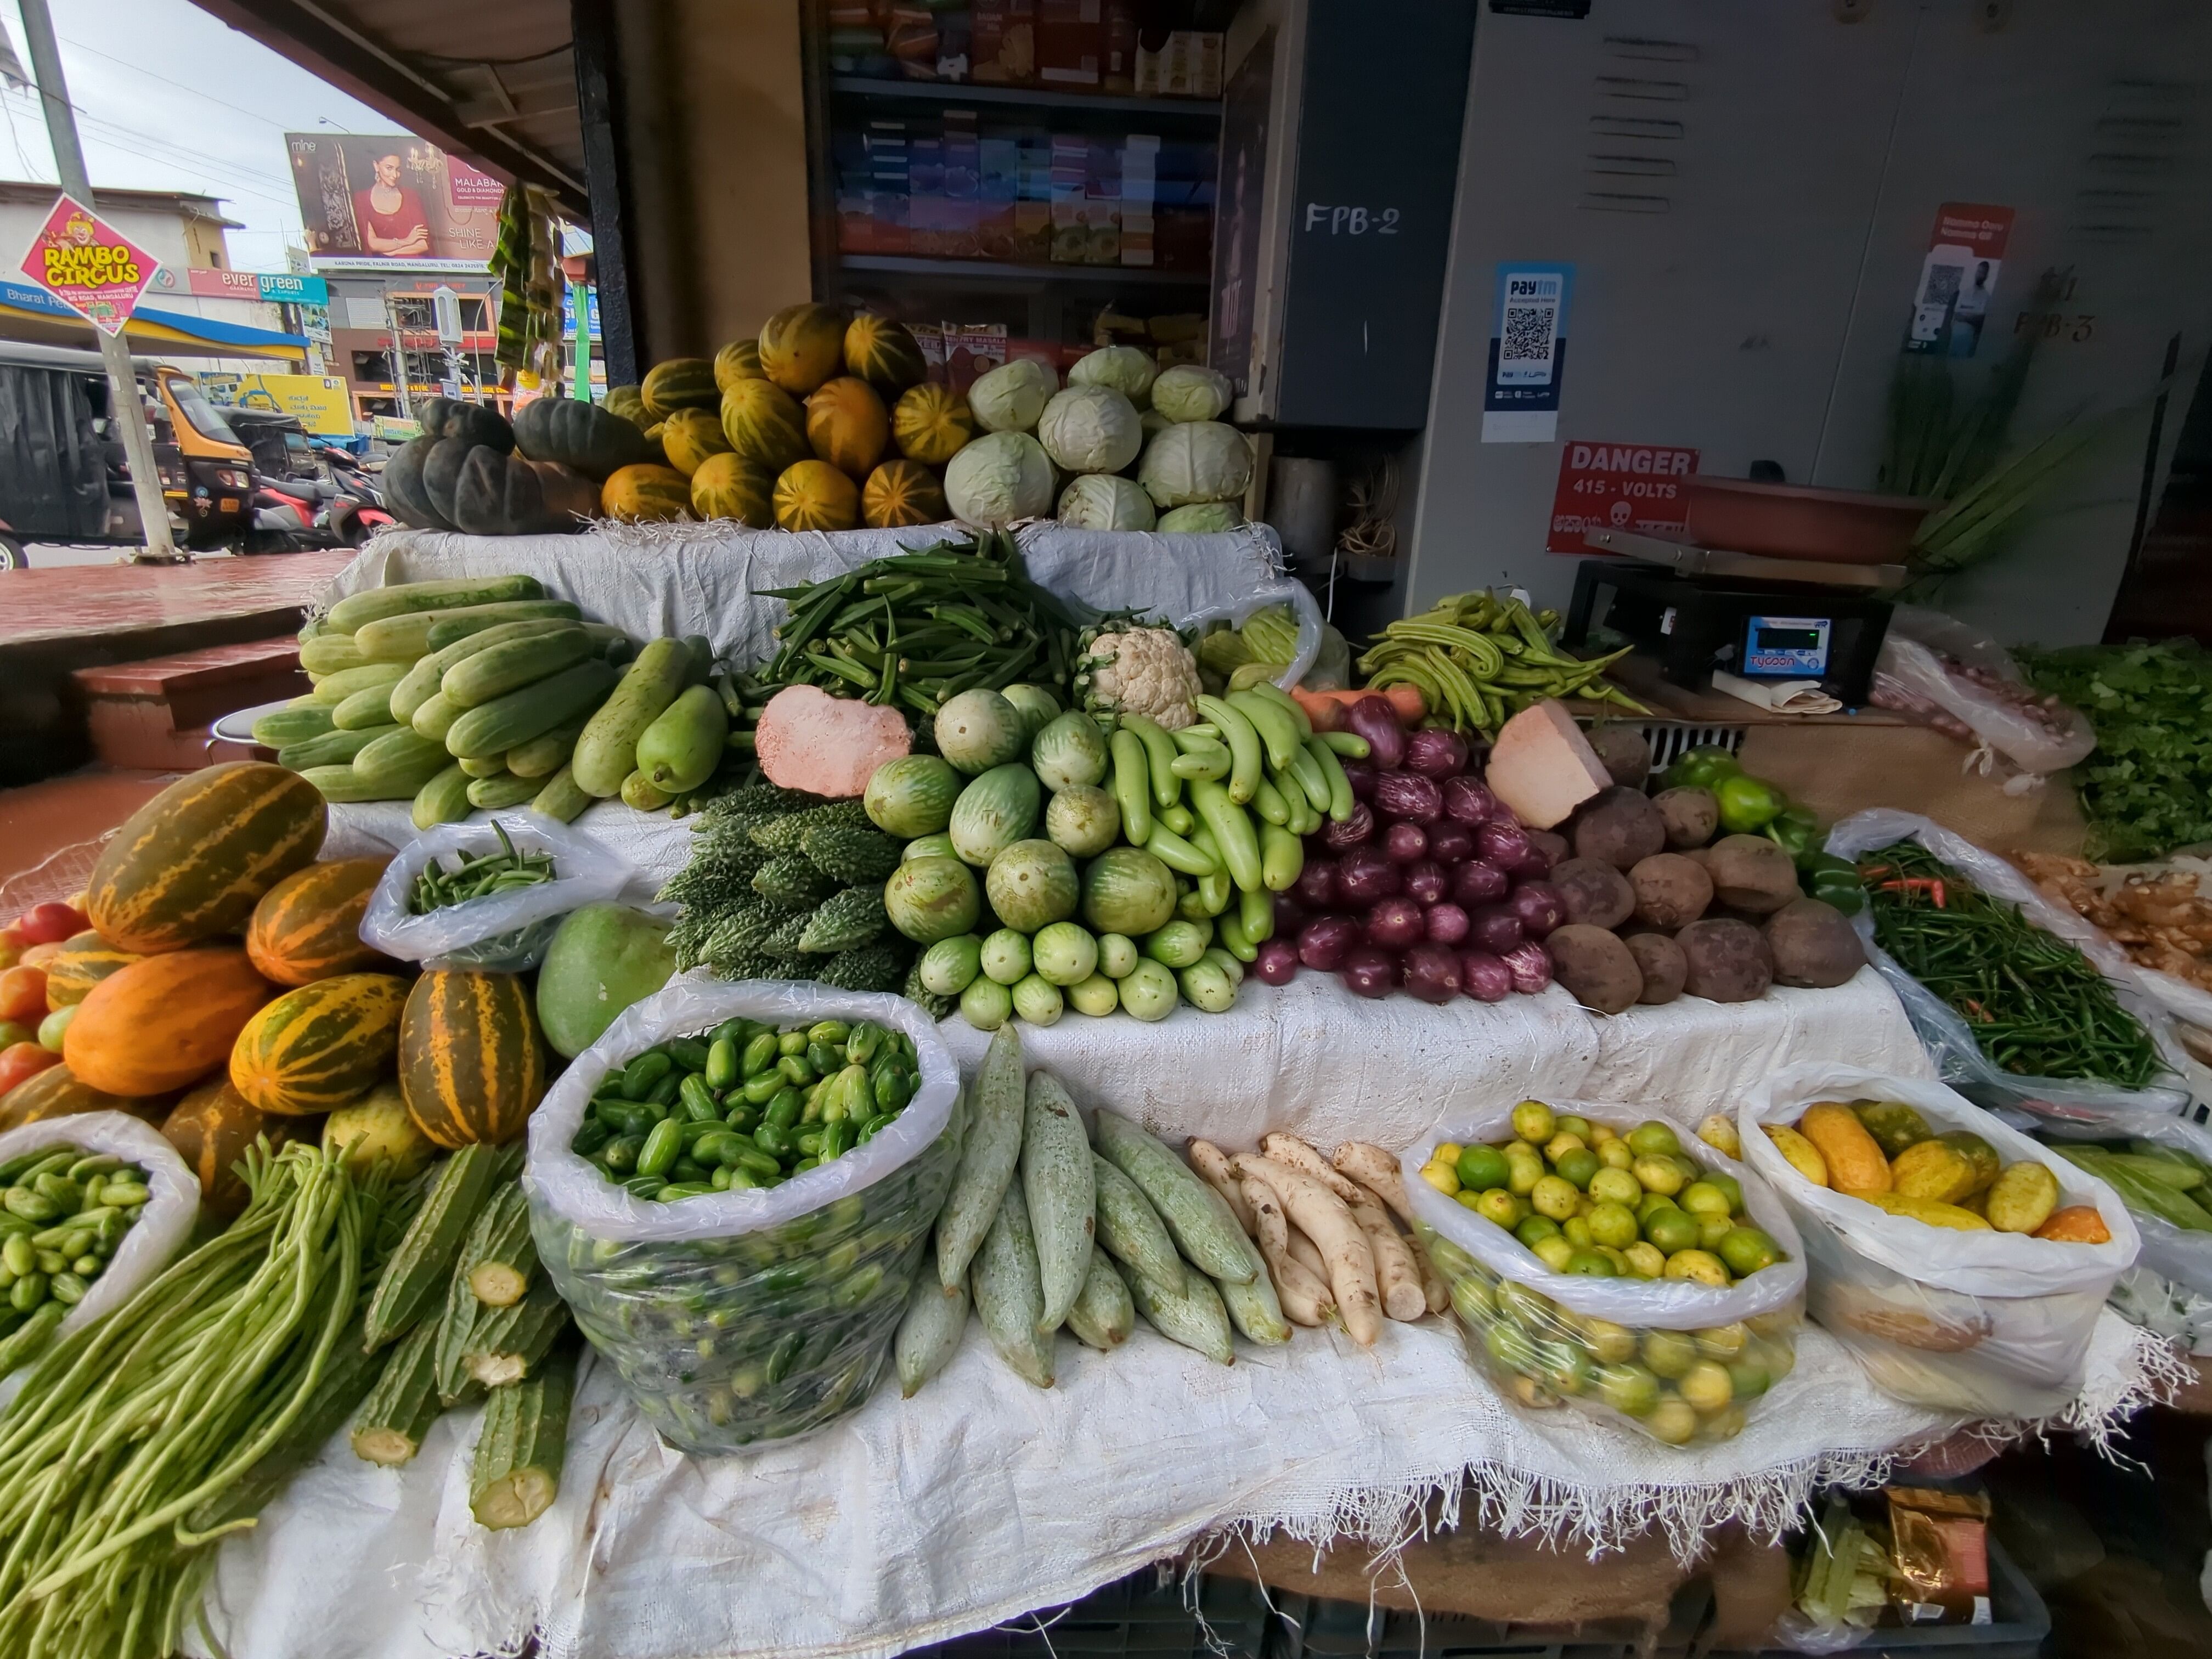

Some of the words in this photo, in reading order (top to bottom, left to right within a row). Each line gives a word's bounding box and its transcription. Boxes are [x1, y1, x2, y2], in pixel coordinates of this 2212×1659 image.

[291, 140, 317, 153] mine
[1305, 202, 1400, 235] FPB-2
[449, 228, 482, 238] SHINE
[460, 240, 484, 250] LIKE
[487, 241, 496, 250] A
[45, 246, 129, 269] RAMBO
[47, 264, 139, 288] CIRCUS
[222, 273, 255, 286] ever
[261, 275, 303, 293] green
[7, 289, 45, 304] Bharat
[1571, 445, 1692, 475] DANGER
[1573, 478, 1606, 494] 415
[1622, 481, 1677, 499] VOLTS
